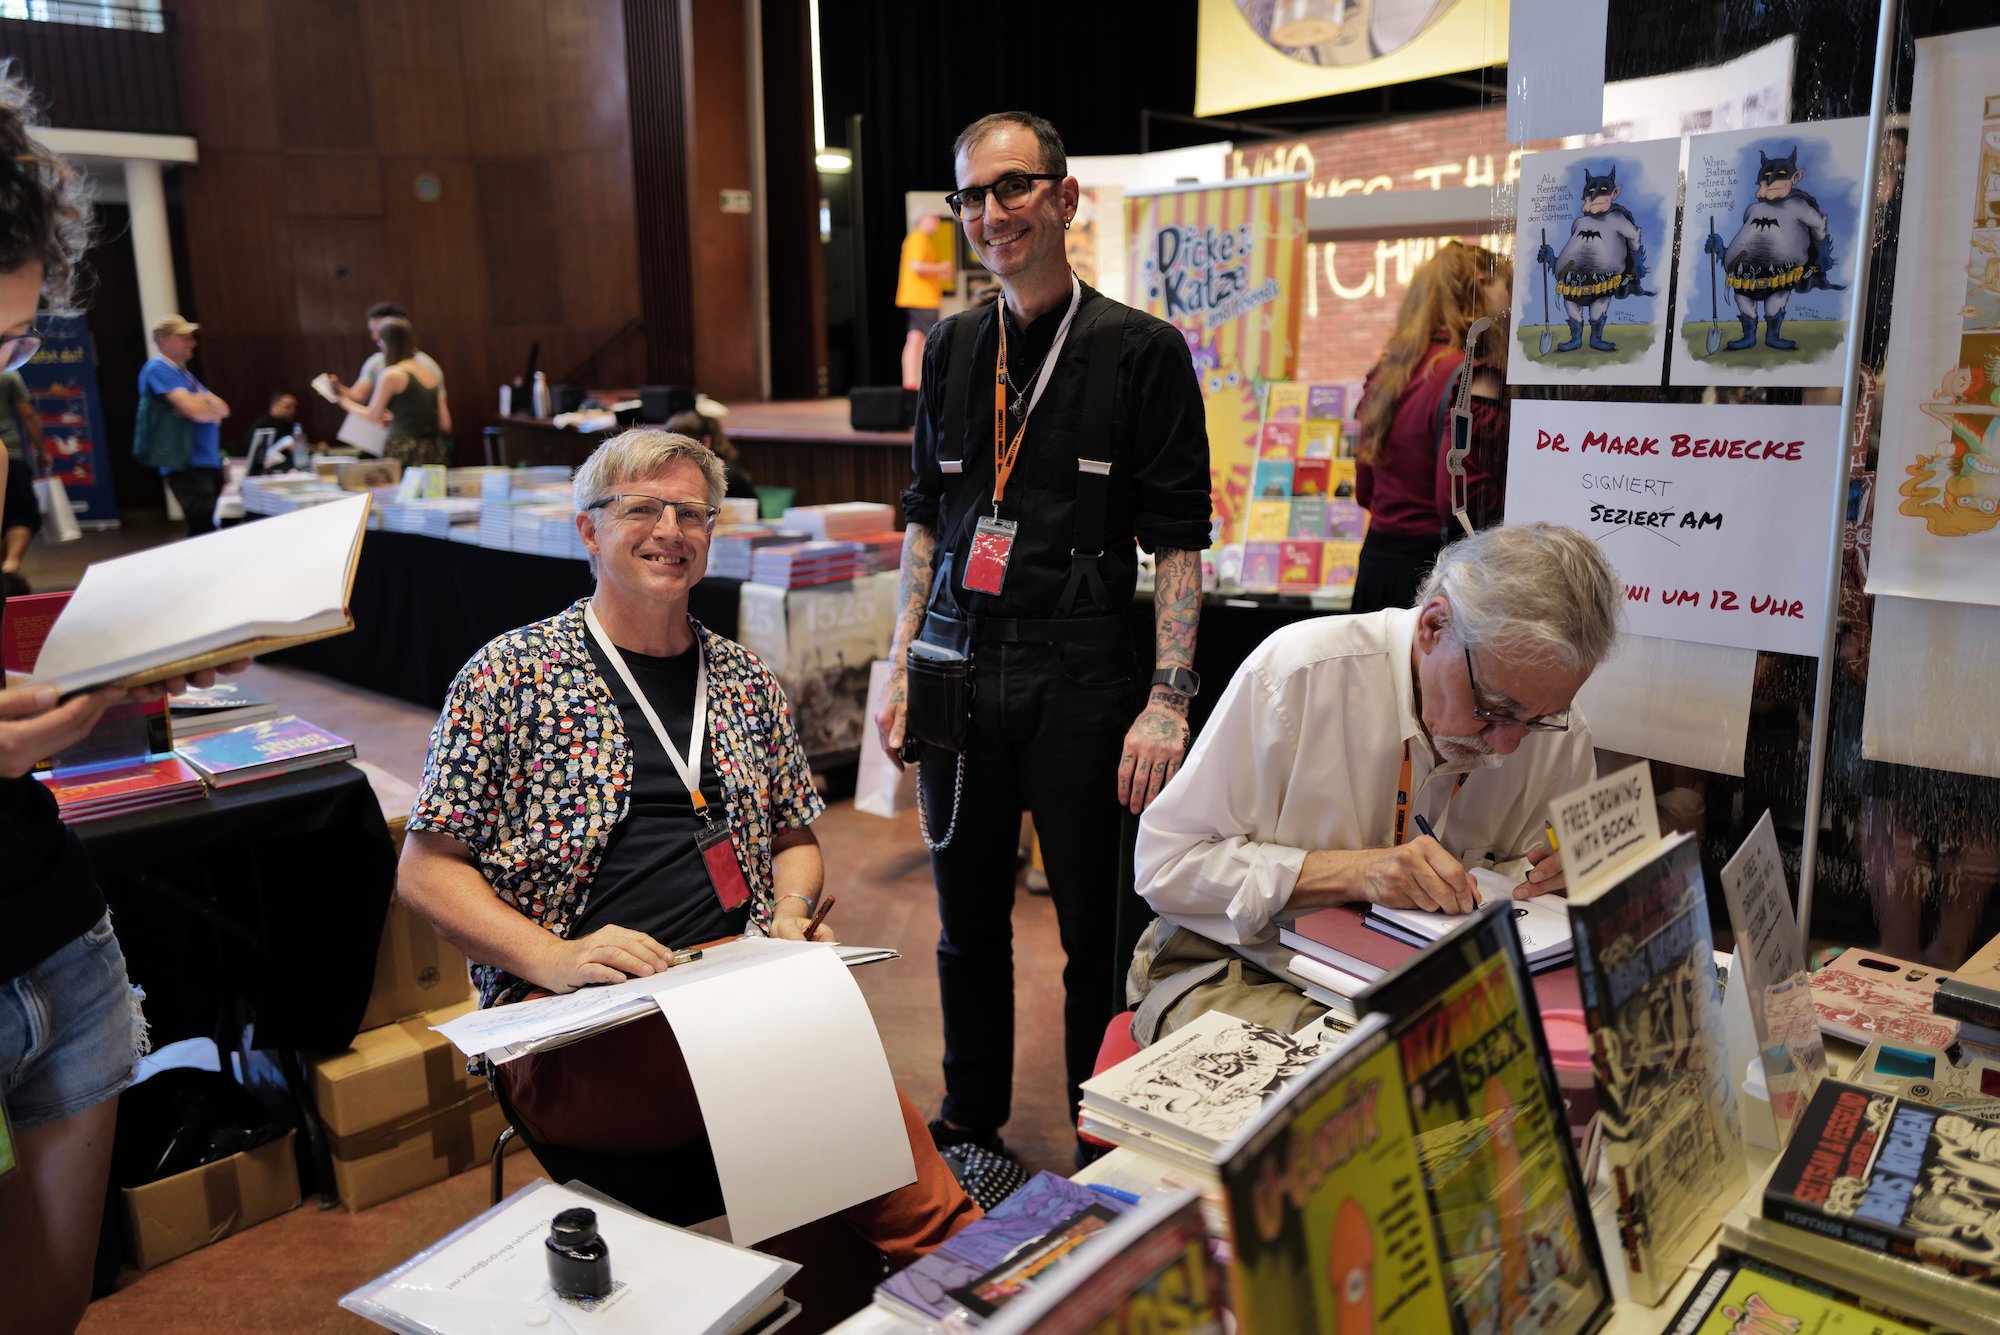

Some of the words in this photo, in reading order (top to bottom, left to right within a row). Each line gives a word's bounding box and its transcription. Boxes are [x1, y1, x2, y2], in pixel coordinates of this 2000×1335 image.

[1703, 156, 1727, 167] When
[1705, 167, 1737, 178] Batman
[1536, 185, 1569, 194] Rentner
[1541, 173, 1556, 184] Als
[1728, 176, 1739, 185] he
[1531, 194, 1557, 203] widmet
[1558, 191, 1574, 201] sich
[1704, 188, 1720, 198] took
[1722, 190, 1733, 199] up
[1528, 214, 1541, 222] dem
[1534, 202, 1569, 213] Batman
[1157, 226, 1235, 274] Dicke
[1163, 265, 1247, 319] Katze
[1582, 431, 1660, 457] MARK
[1671, 434, 1806, 460] BENECKE
[1581, 473, 1673, 497] SIGNIERT
[1590, 504, 1676, 528] SEZIERT
[1679, 511, 1723, 530] AM
[1662, 589, 1700, 607] UM
[1710, 589, 1740, 611] 12
[1750, 594, 1805, 619] UHR
[1562, 801, 1591, 836] FREE
[1590, 776, 1642, 819] DRAWING
[1573, 831, 1599, 861] WITH
[1462, 1010, 1527, 1095] SEX
[1875, 1107, 1936, 1179] KITCHEN
